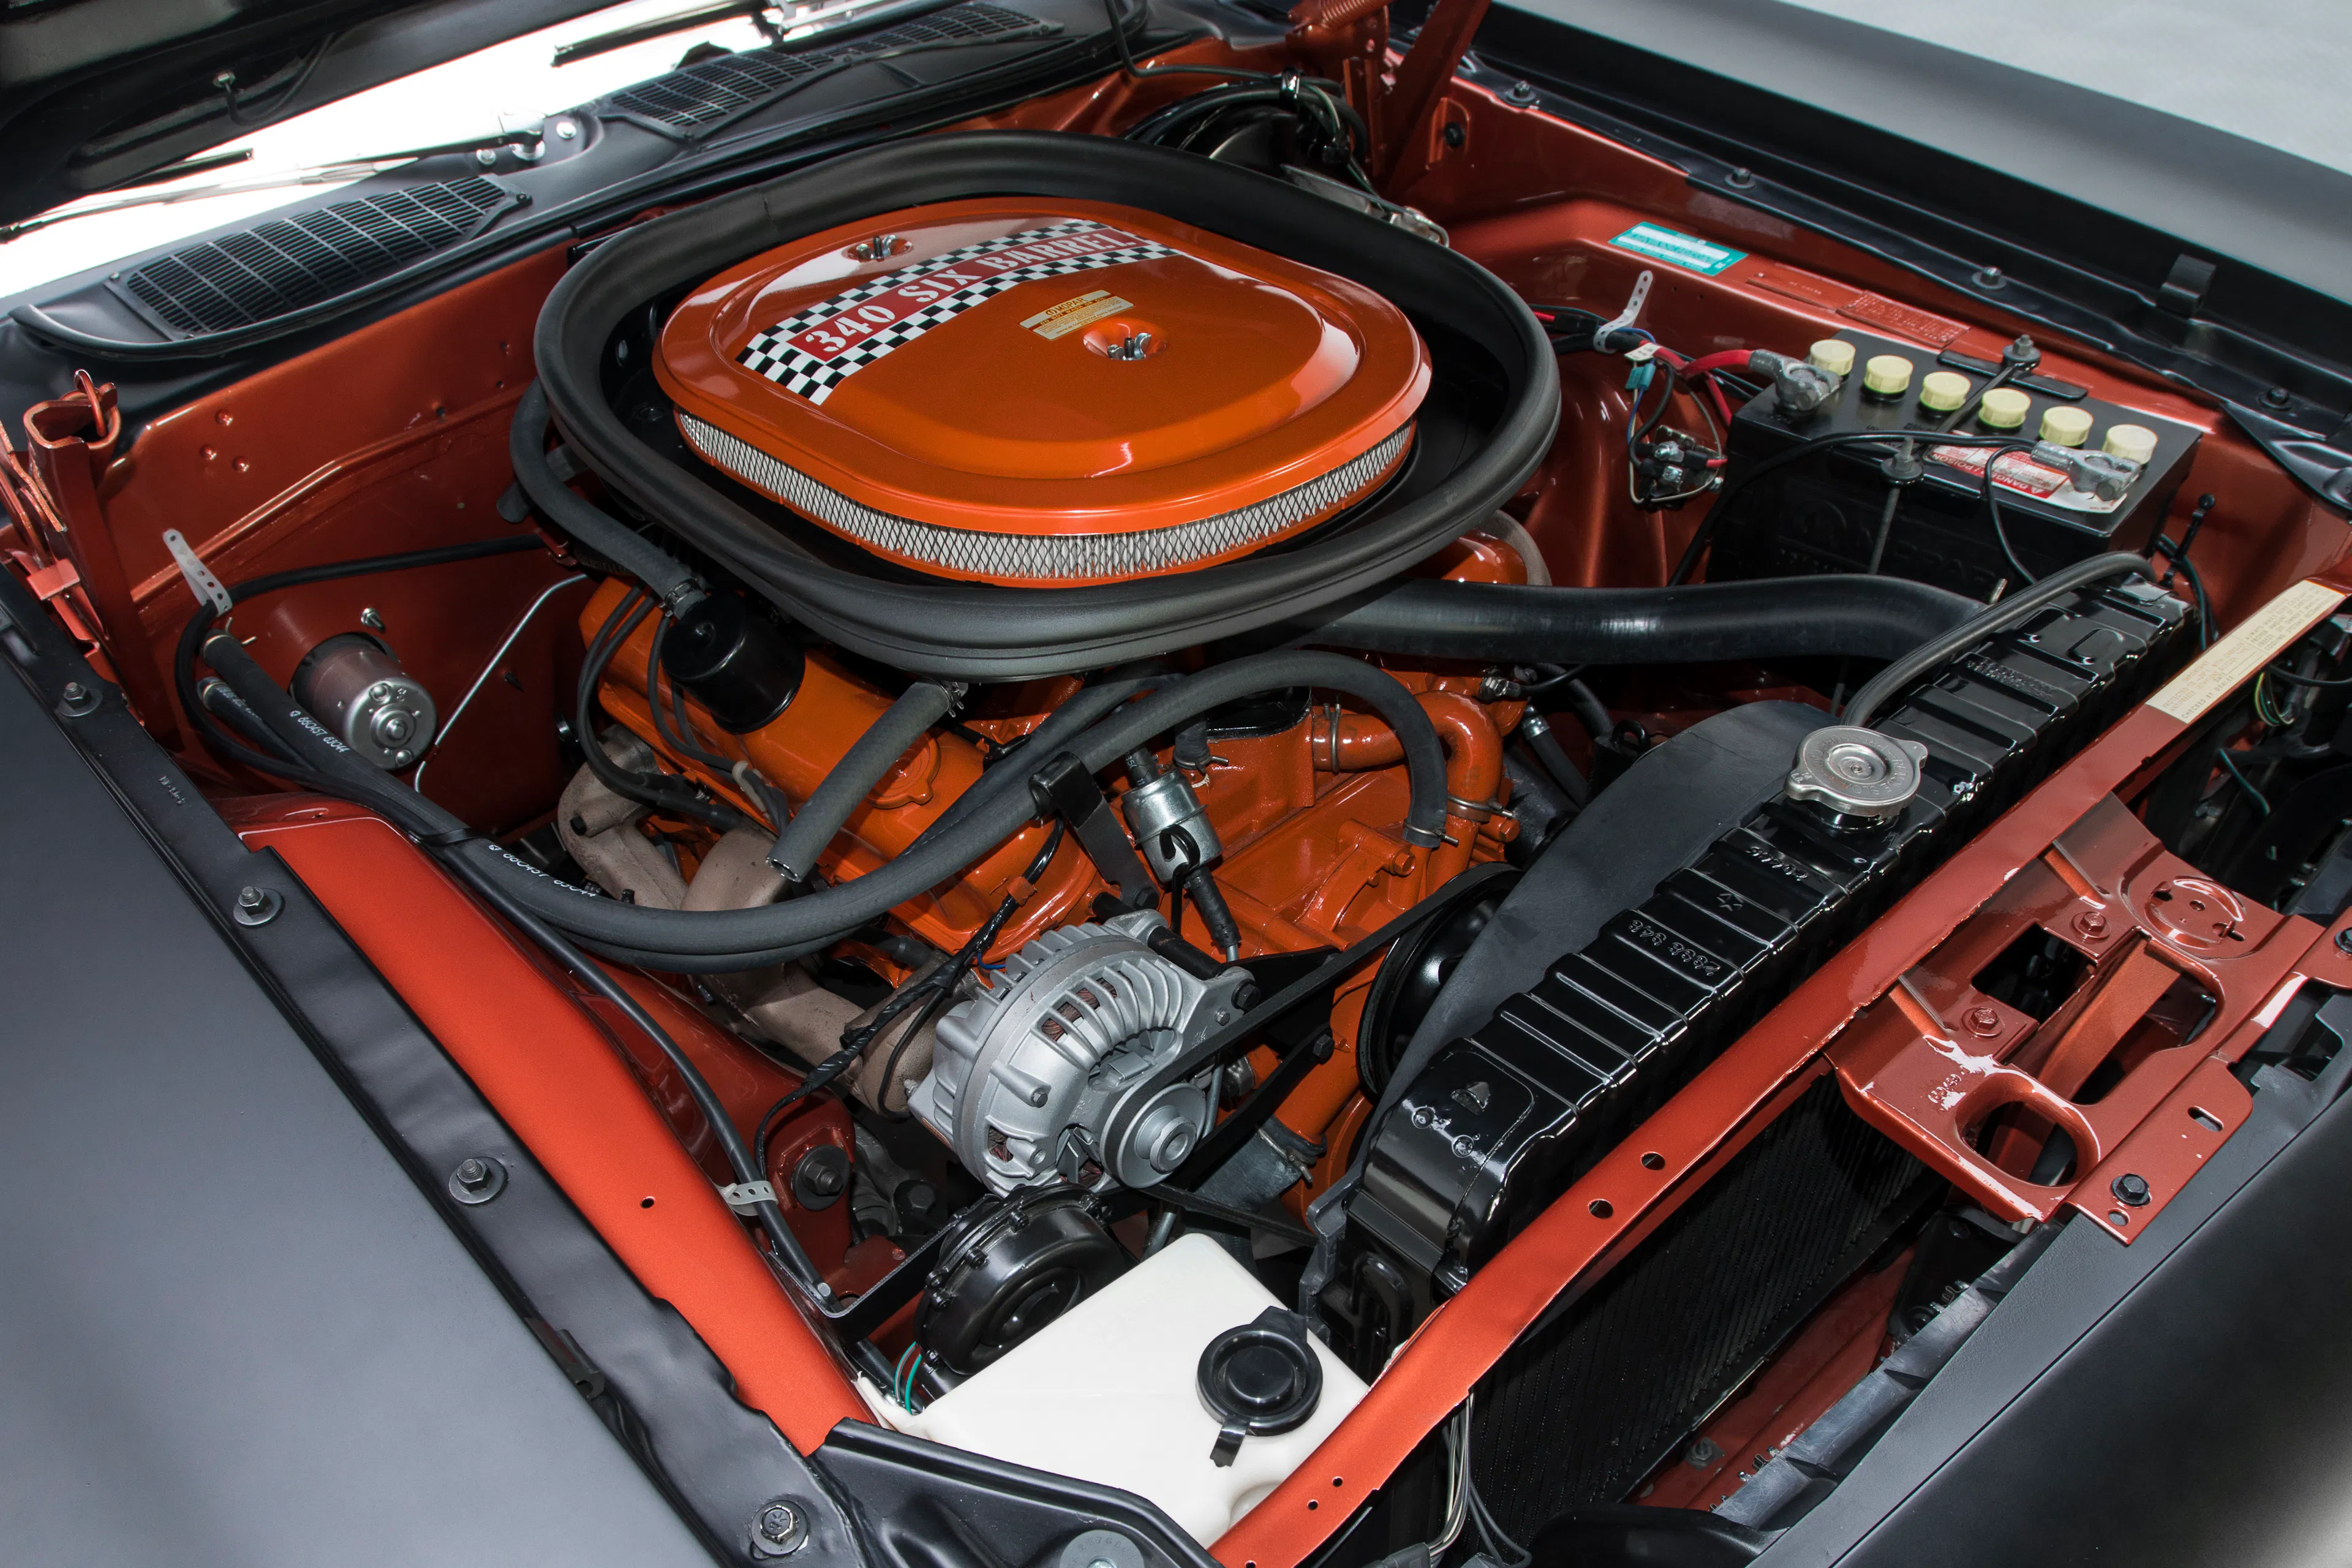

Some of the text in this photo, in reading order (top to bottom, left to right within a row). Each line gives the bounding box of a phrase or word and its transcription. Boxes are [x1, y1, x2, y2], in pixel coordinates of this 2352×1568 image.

[805, 233, 1137, 352] 340 SIX BARREL
[1054, 297, 1088, 313] MOPAR
[1931, 452, 1973, 472] POISON
[2160, 687, 2190, 708] PROTECTED
[2180, 698, 2207, 718] CHECKED
[2213, 675, 2235, 691] DEALER
